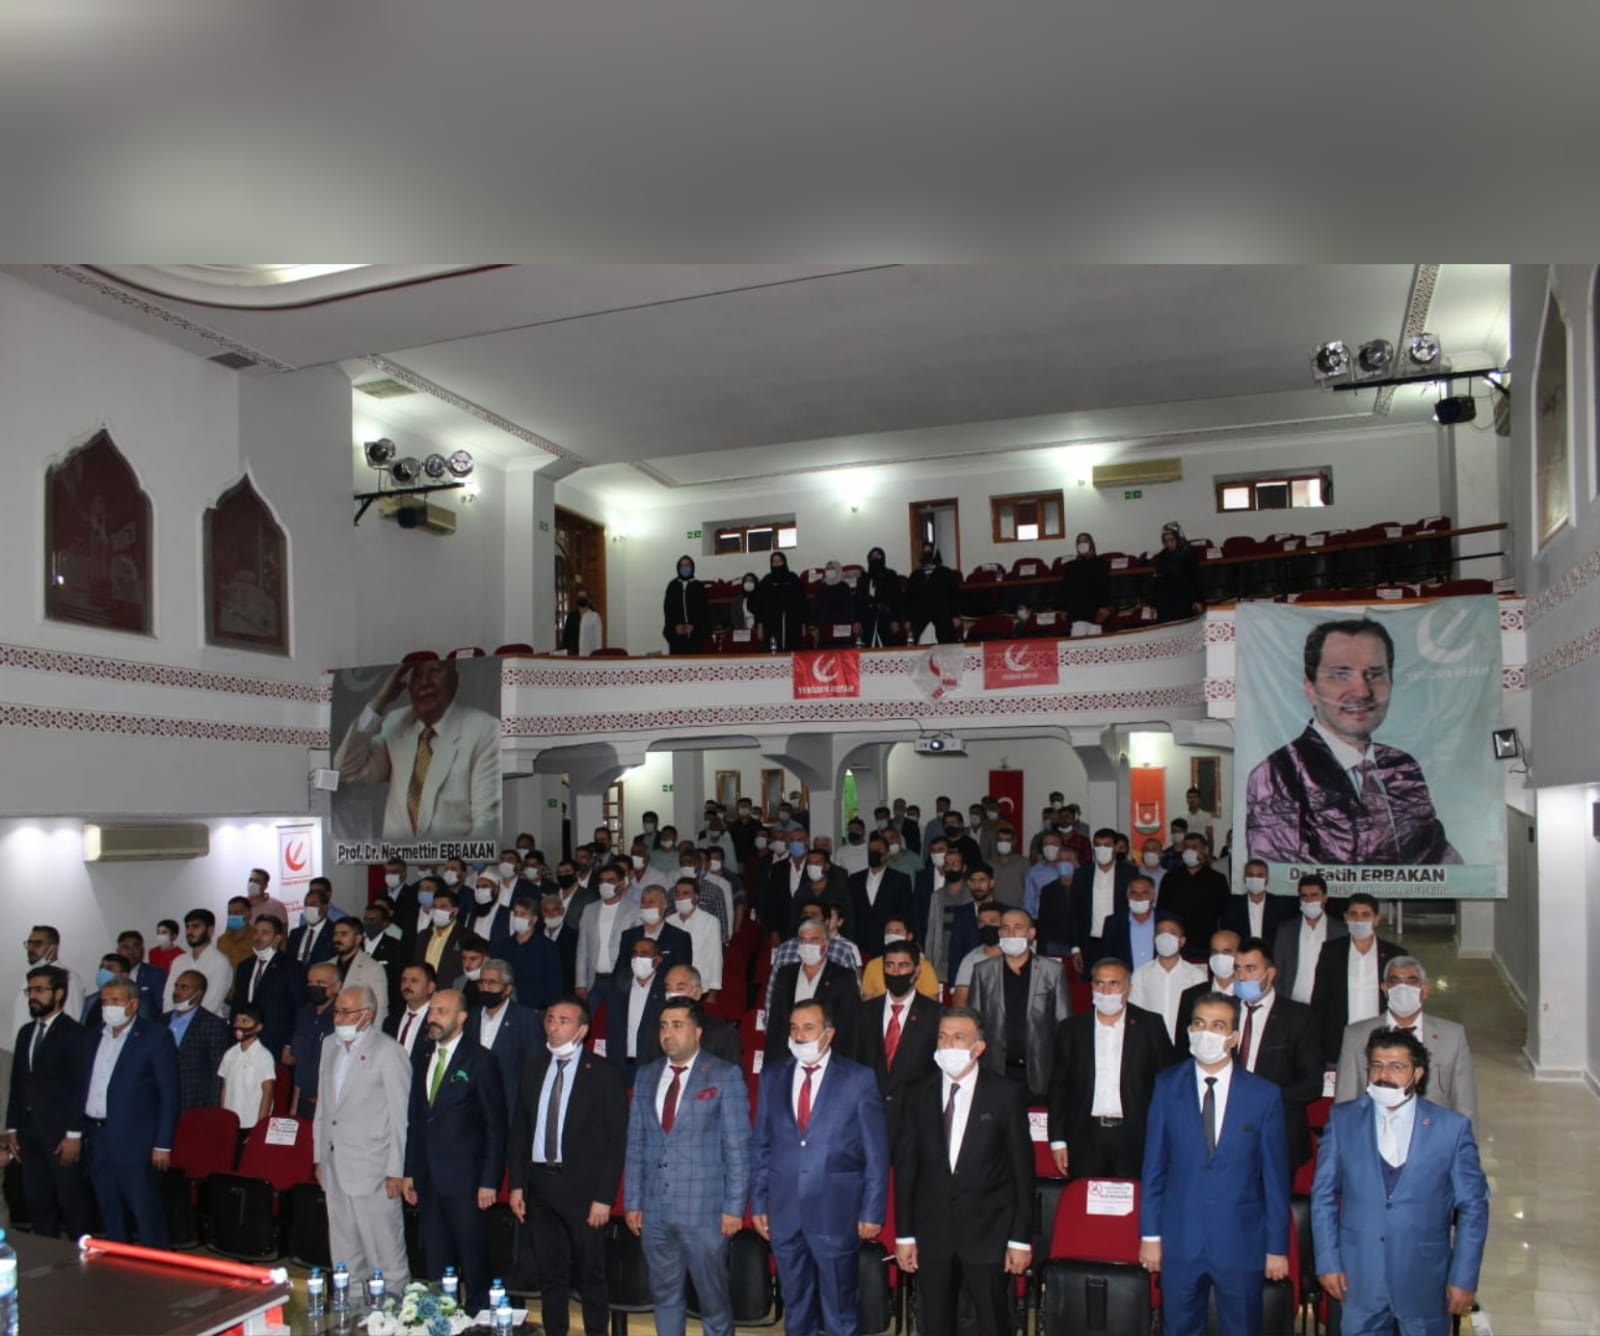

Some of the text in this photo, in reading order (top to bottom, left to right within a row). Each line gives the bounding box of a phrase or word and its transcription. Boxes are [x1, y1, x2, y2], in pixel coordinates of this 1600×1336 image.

[338, 843, 496, 860] Prof. Dr. Necmettin ERBAKAN
[1290, 868, 1445, 882] Dr Fatih ERBAKAN
